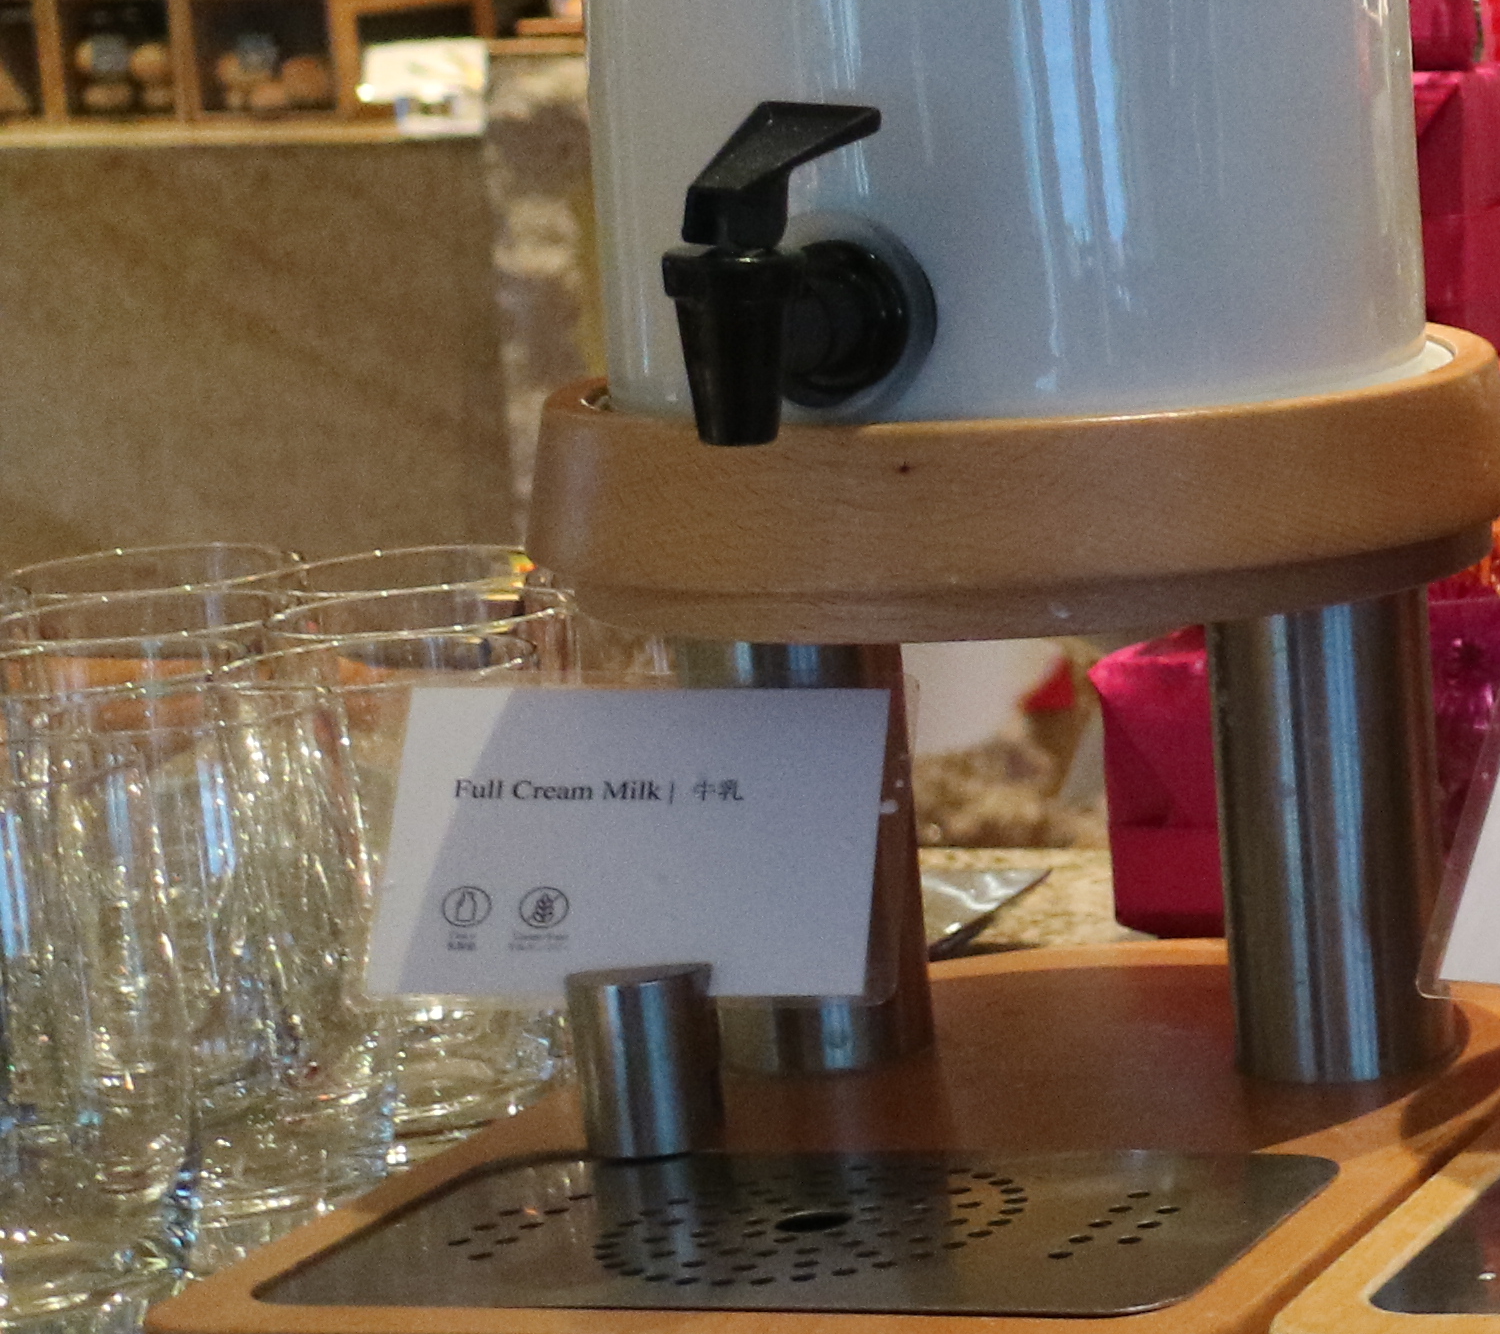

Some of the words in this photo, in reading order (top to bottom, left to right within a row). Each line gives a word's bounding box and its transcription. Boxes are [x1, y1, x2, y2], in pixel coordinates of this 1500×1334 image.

[454, 778, 502, 800] Full
[512, 779, 594, 801] Cream
[602, 779, 662, 802] Milk
[692, 778, 745, 802] 牛乳
